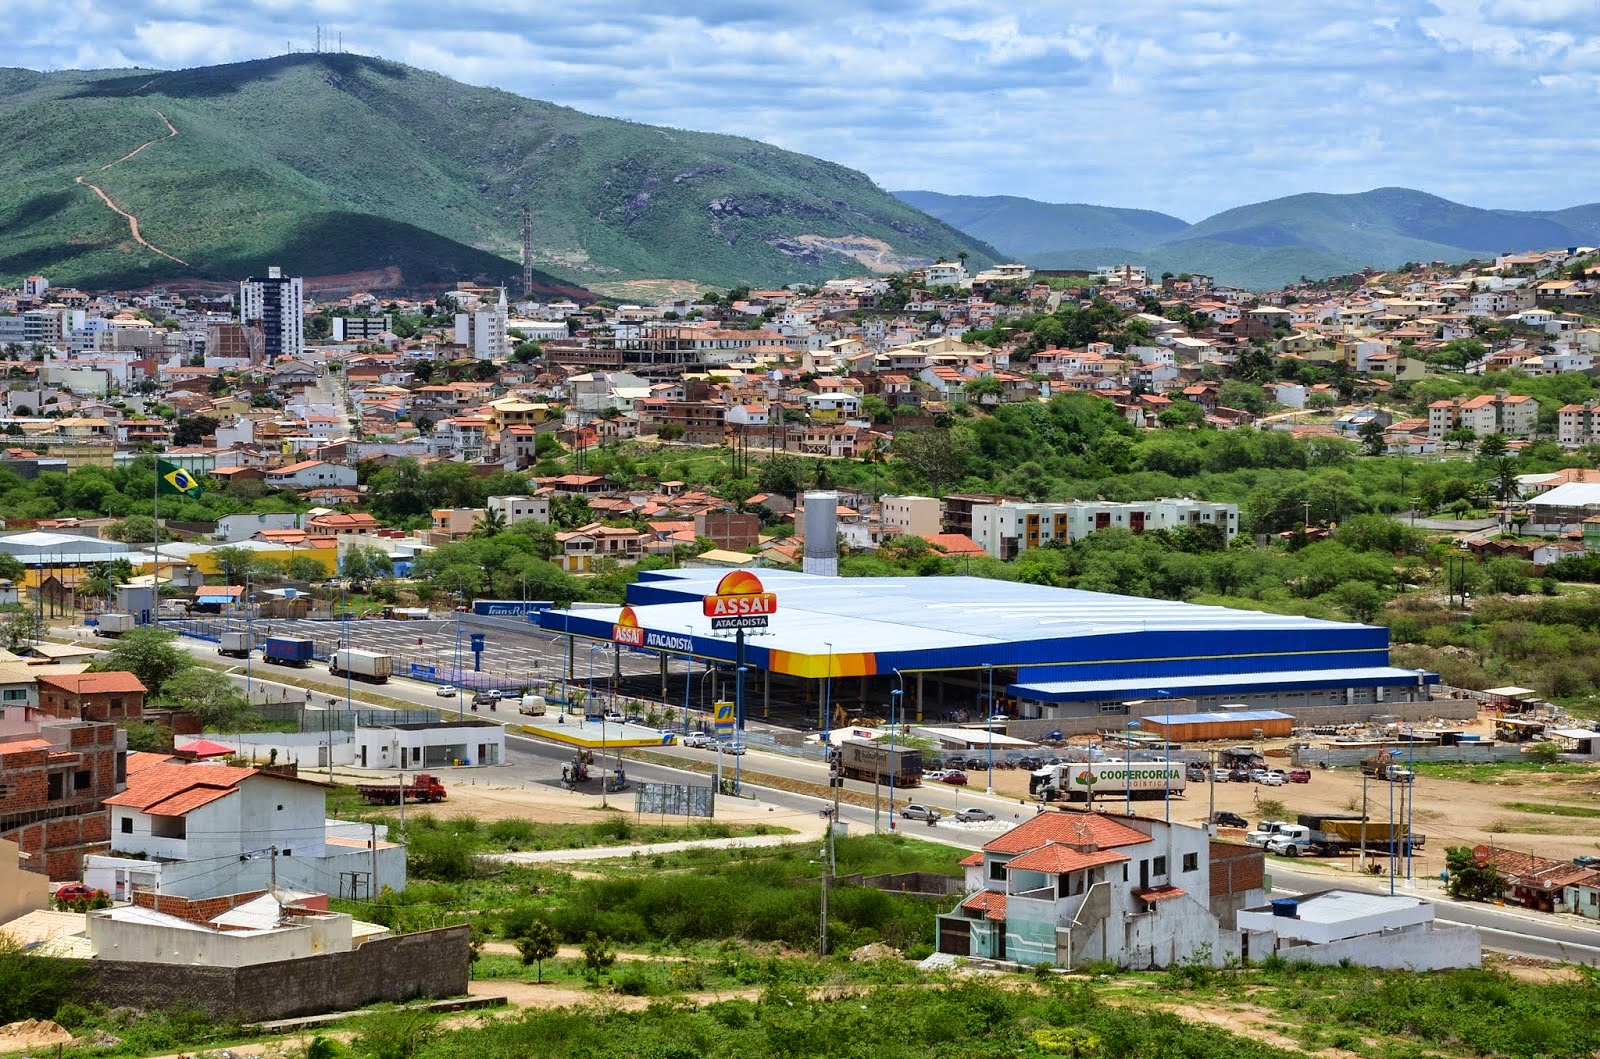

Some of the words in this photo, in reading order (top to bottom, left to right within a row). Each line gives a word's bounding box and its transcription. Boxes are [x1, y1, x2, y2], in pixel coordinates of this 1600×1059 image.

[715, 618, 767, 628] ATACADISTA
[647, 633, 693, 652] ATACADISTA
[1100, 769, 1180, 780] COOPERCORDIA
